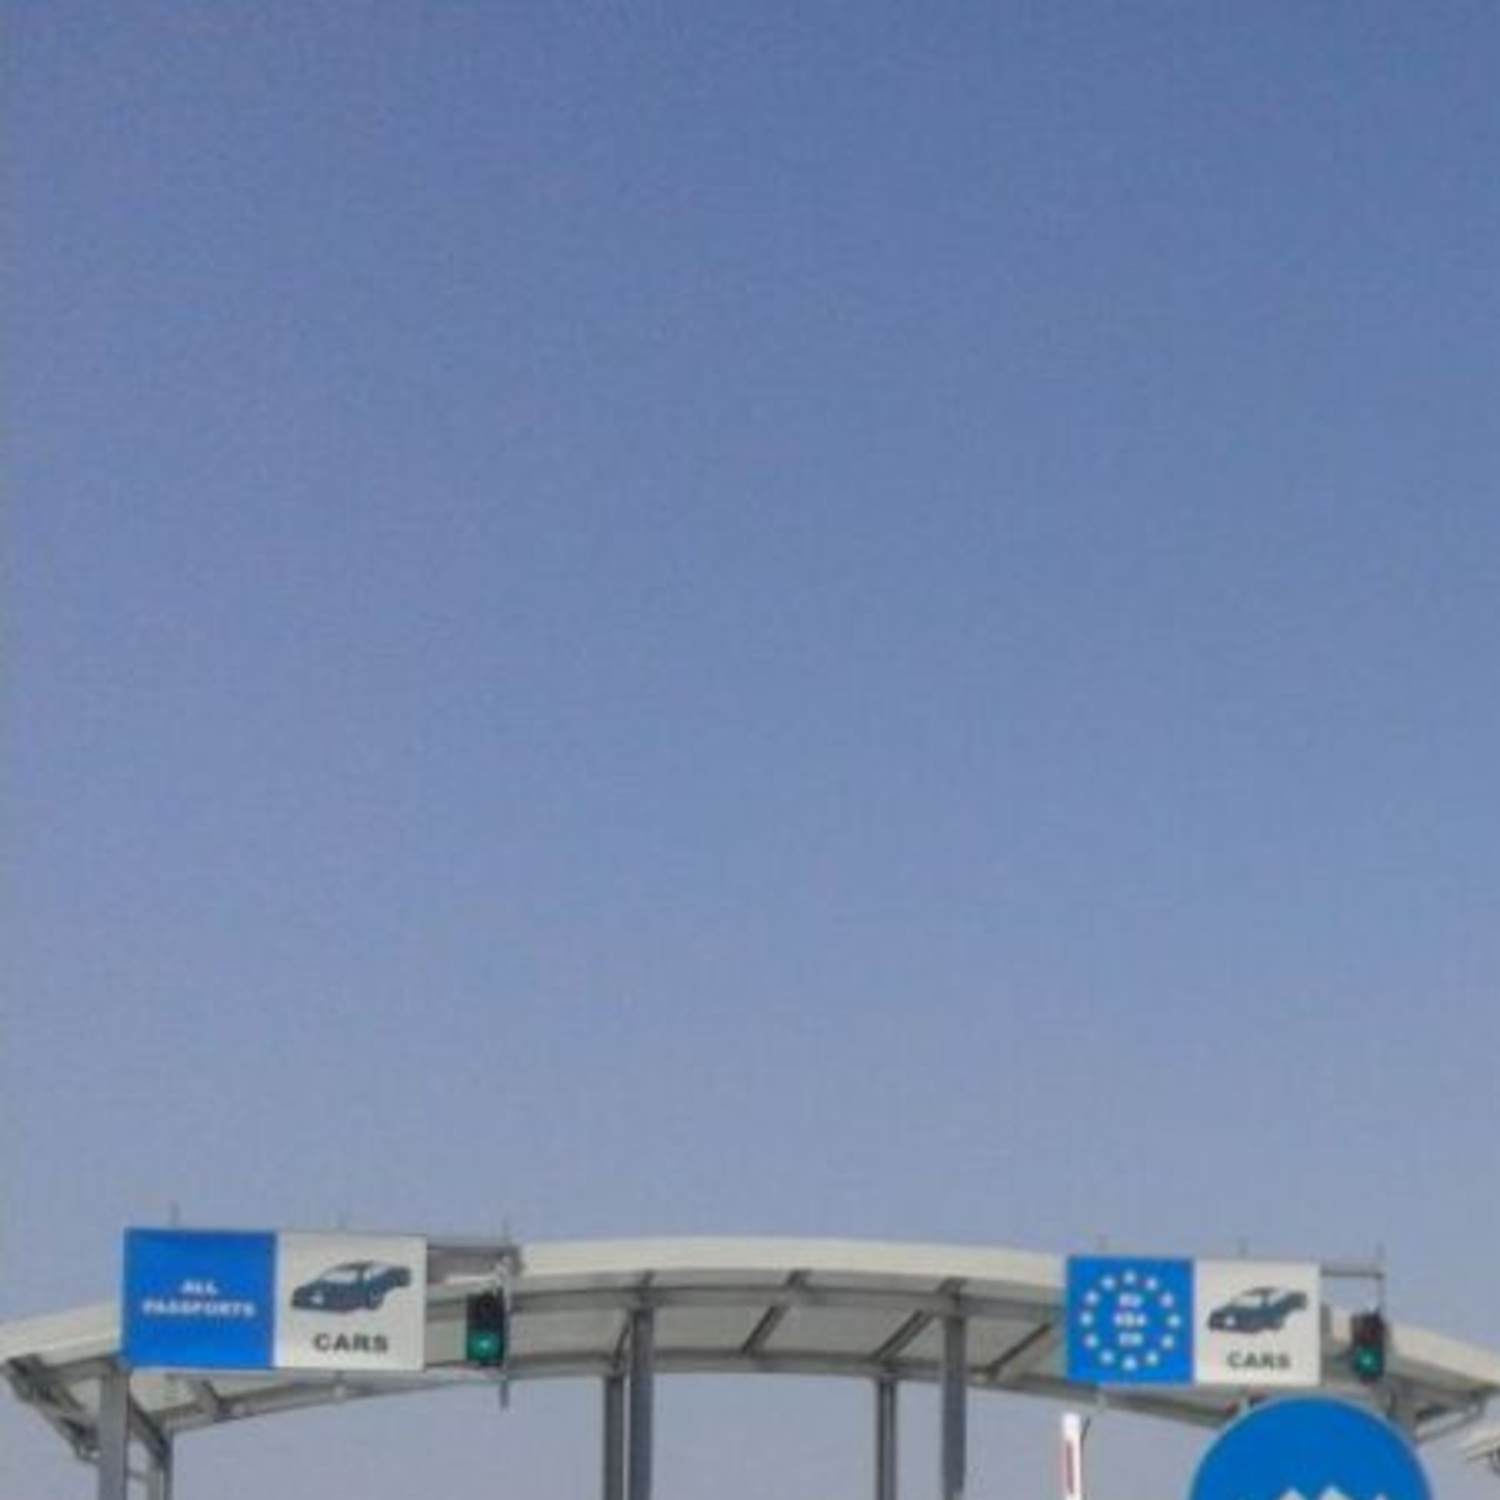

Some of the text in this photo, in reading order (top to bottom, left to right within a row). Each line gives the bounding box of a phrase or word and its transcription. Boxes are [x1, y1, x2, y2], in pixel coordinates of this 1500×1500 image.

[180, 1279, 218, 1295] ALL
[142, 1299, 256, 1318] PASSPORTS
[313, 1332, 389, 1352] CARS
[1226, 1351, 1291, 1370] CARS
